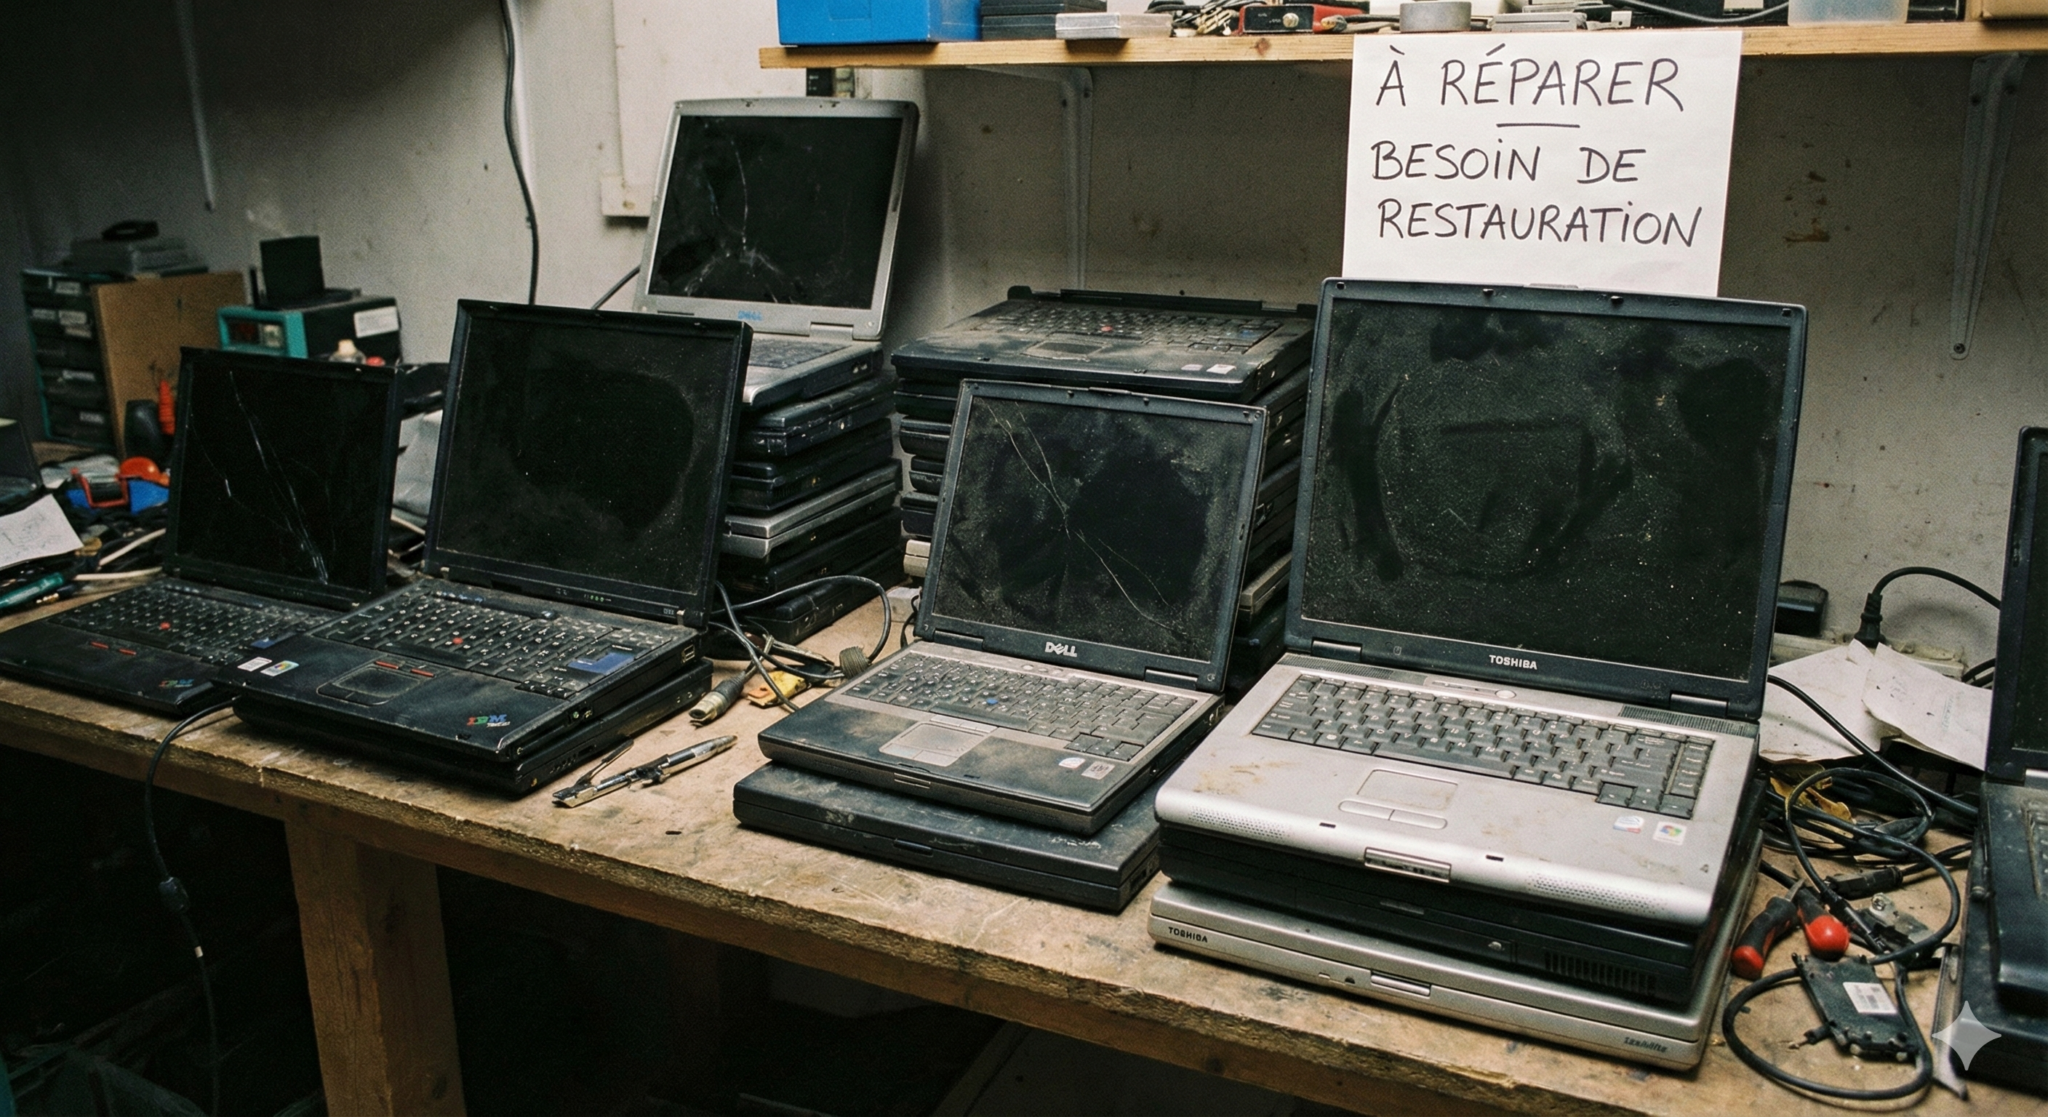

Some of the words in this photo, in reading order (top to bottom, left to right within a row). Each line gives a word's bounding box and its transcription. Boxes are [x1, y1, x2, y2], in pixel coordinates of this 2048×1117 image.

[1376, 44, 1406, 107] À
[1440, 43, 1684, 112] RÉPARER
[1577, 146, 1647, 184] DE
[1044, 641, 1078, 658] DELL
[1488, 654, 1538, 671] TOSHIBA
